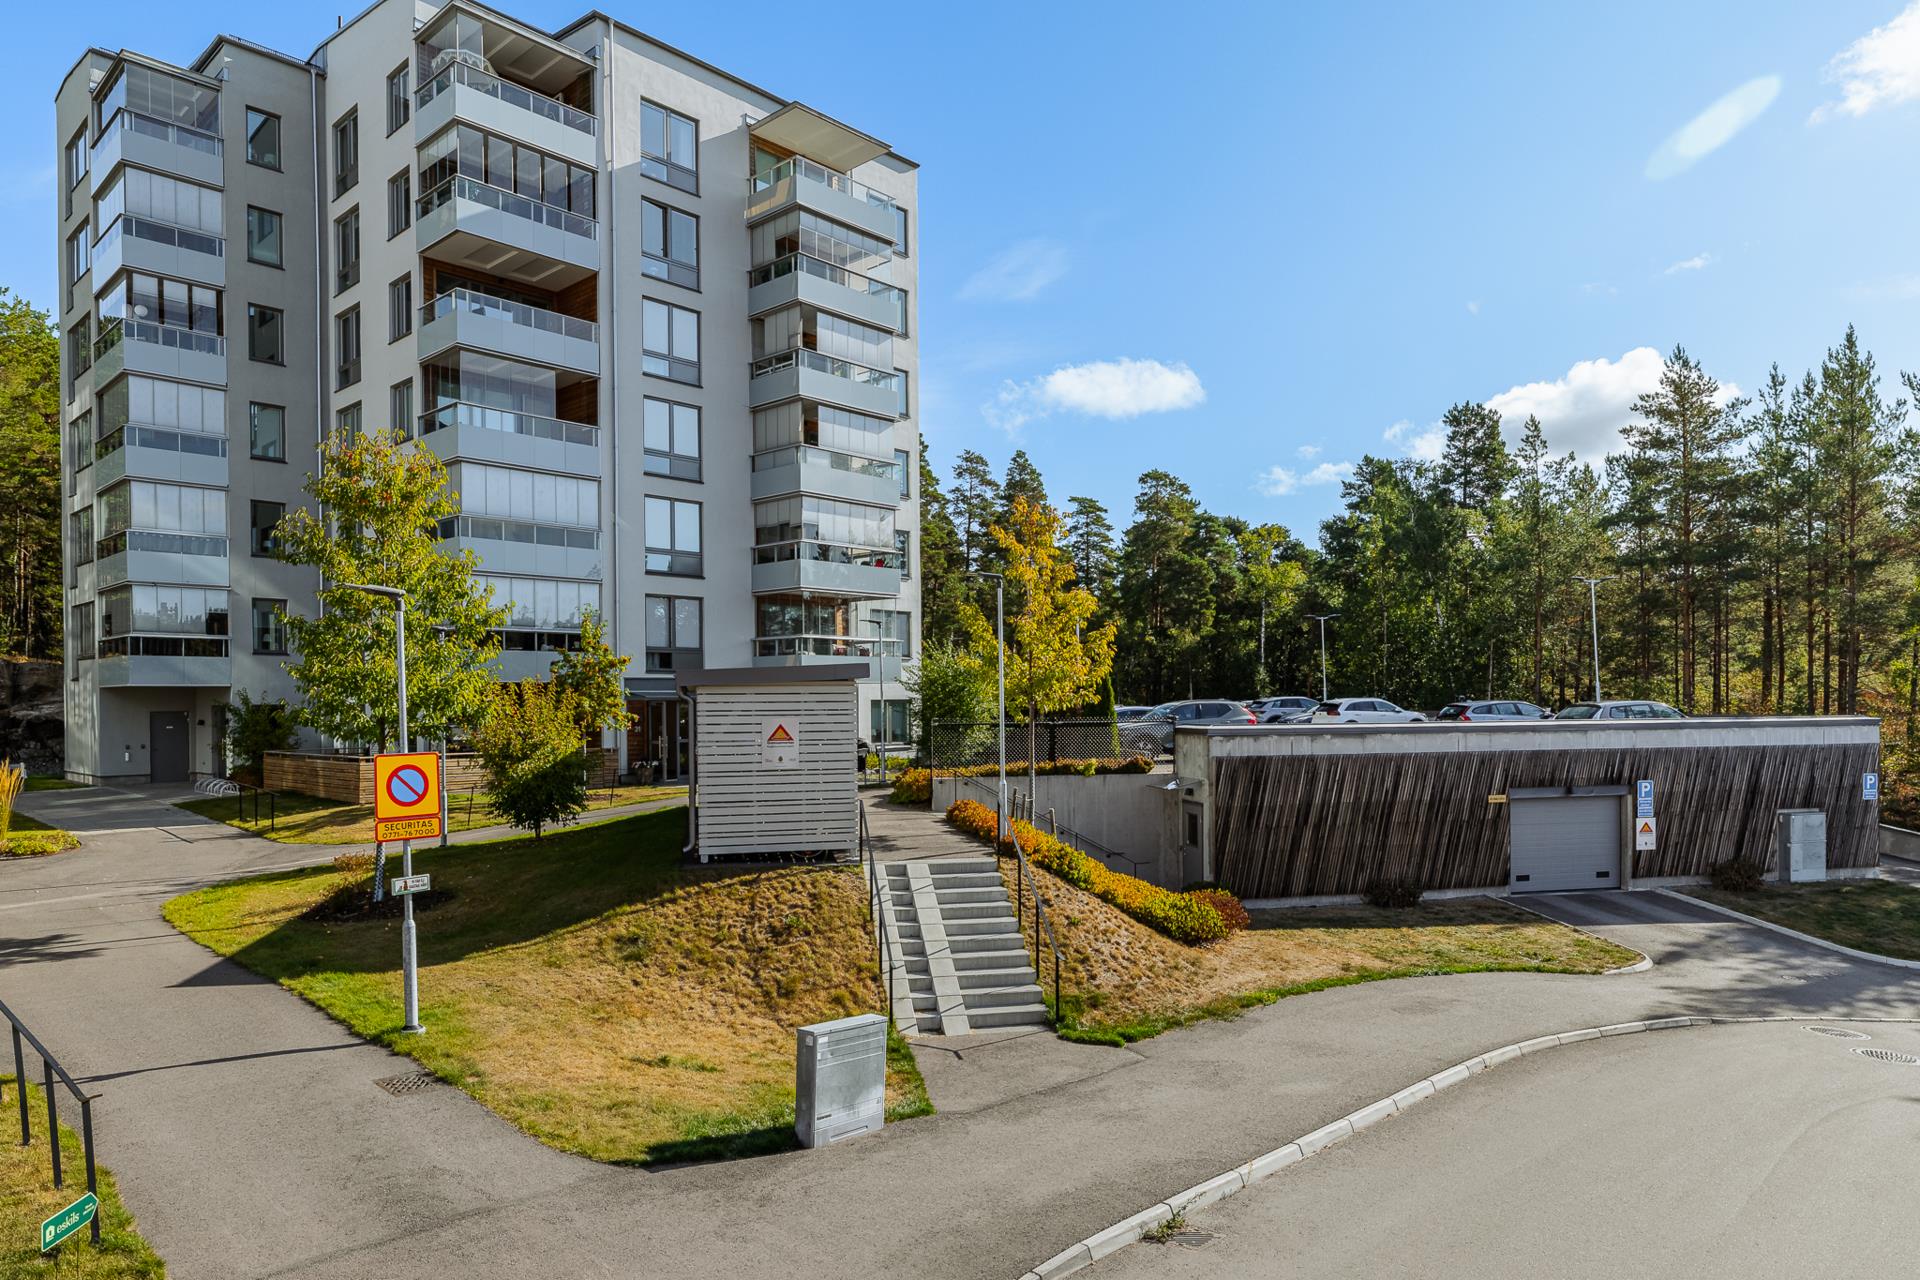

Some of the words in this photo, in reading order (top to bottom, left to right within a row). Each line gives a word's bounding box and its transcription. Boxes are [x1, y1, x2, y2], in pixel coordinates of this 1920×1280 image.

[1641, 782, 1651, 797] P
[384, 820, 433, 831] SECURITAS
[57, 1212, 80, 1234] eskils
